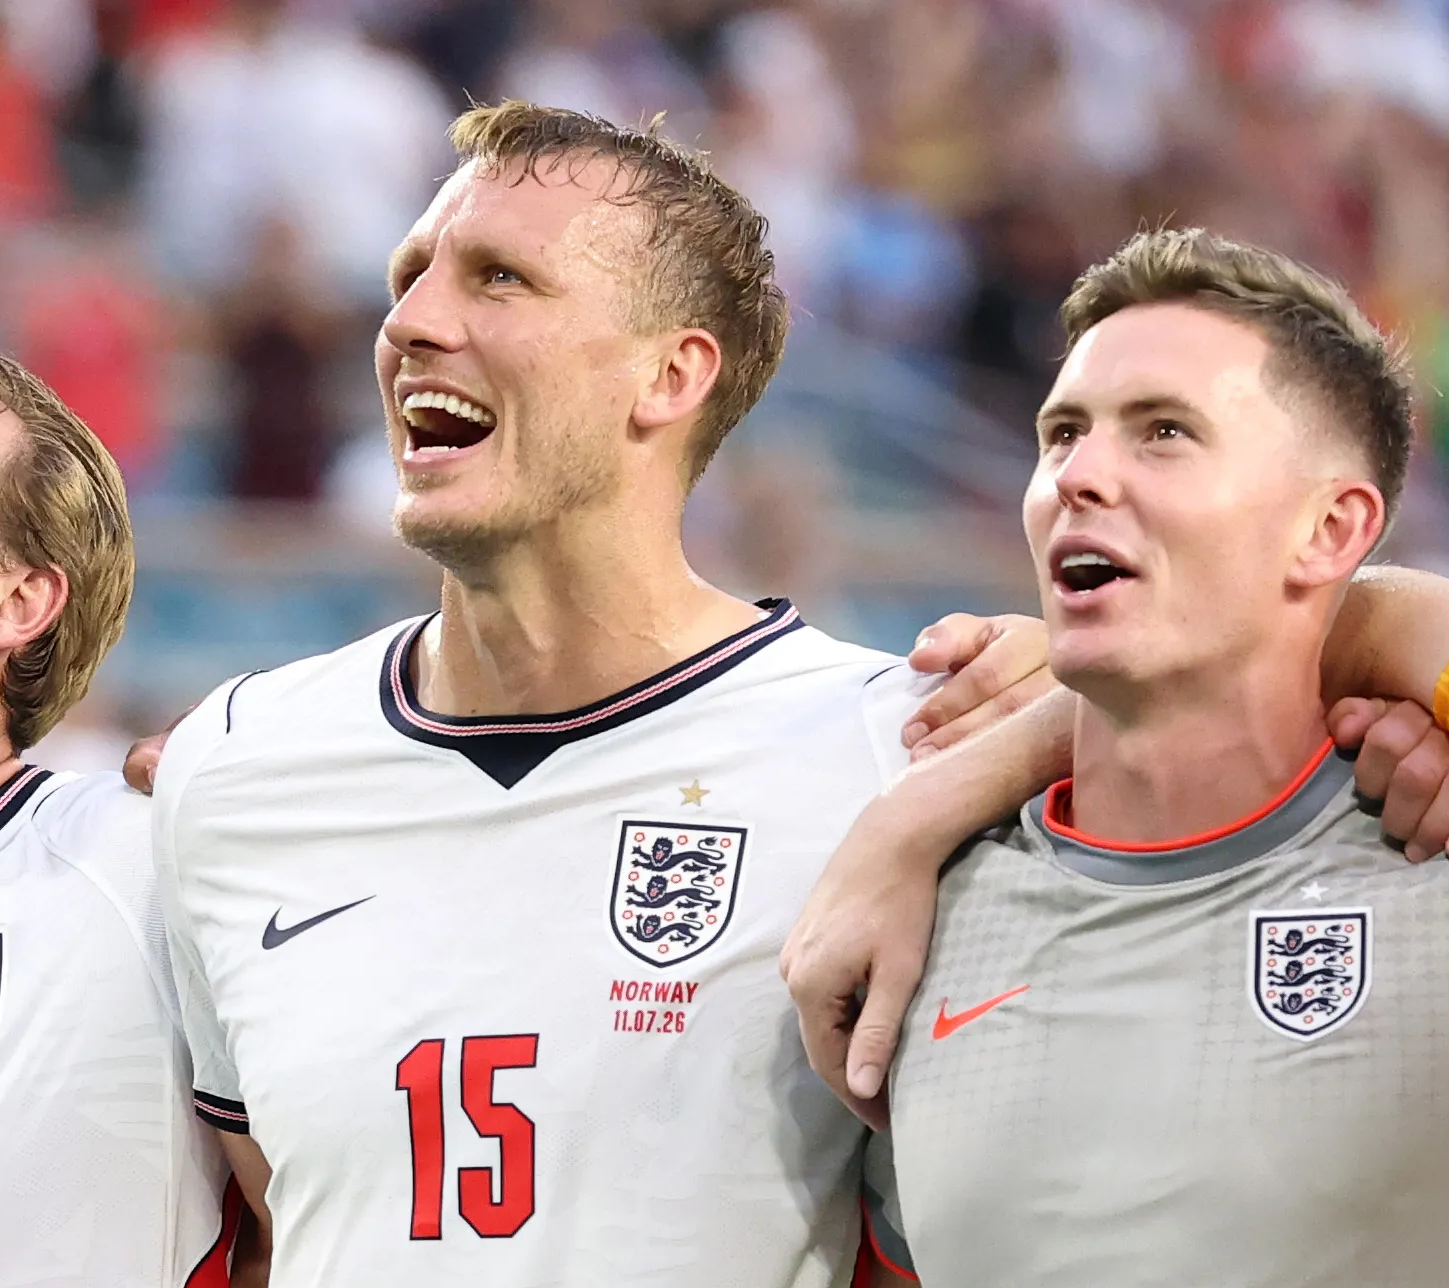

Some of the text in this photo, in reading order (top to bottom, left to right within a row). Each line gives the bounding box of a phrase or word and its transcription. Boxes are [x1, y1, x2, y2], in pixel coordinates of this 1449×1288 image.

[610, 979, 699, 1004] NORWAY
[613, 1008, 686, 1033] 11.07.26
[395, 1033, 540, 1241] 15
